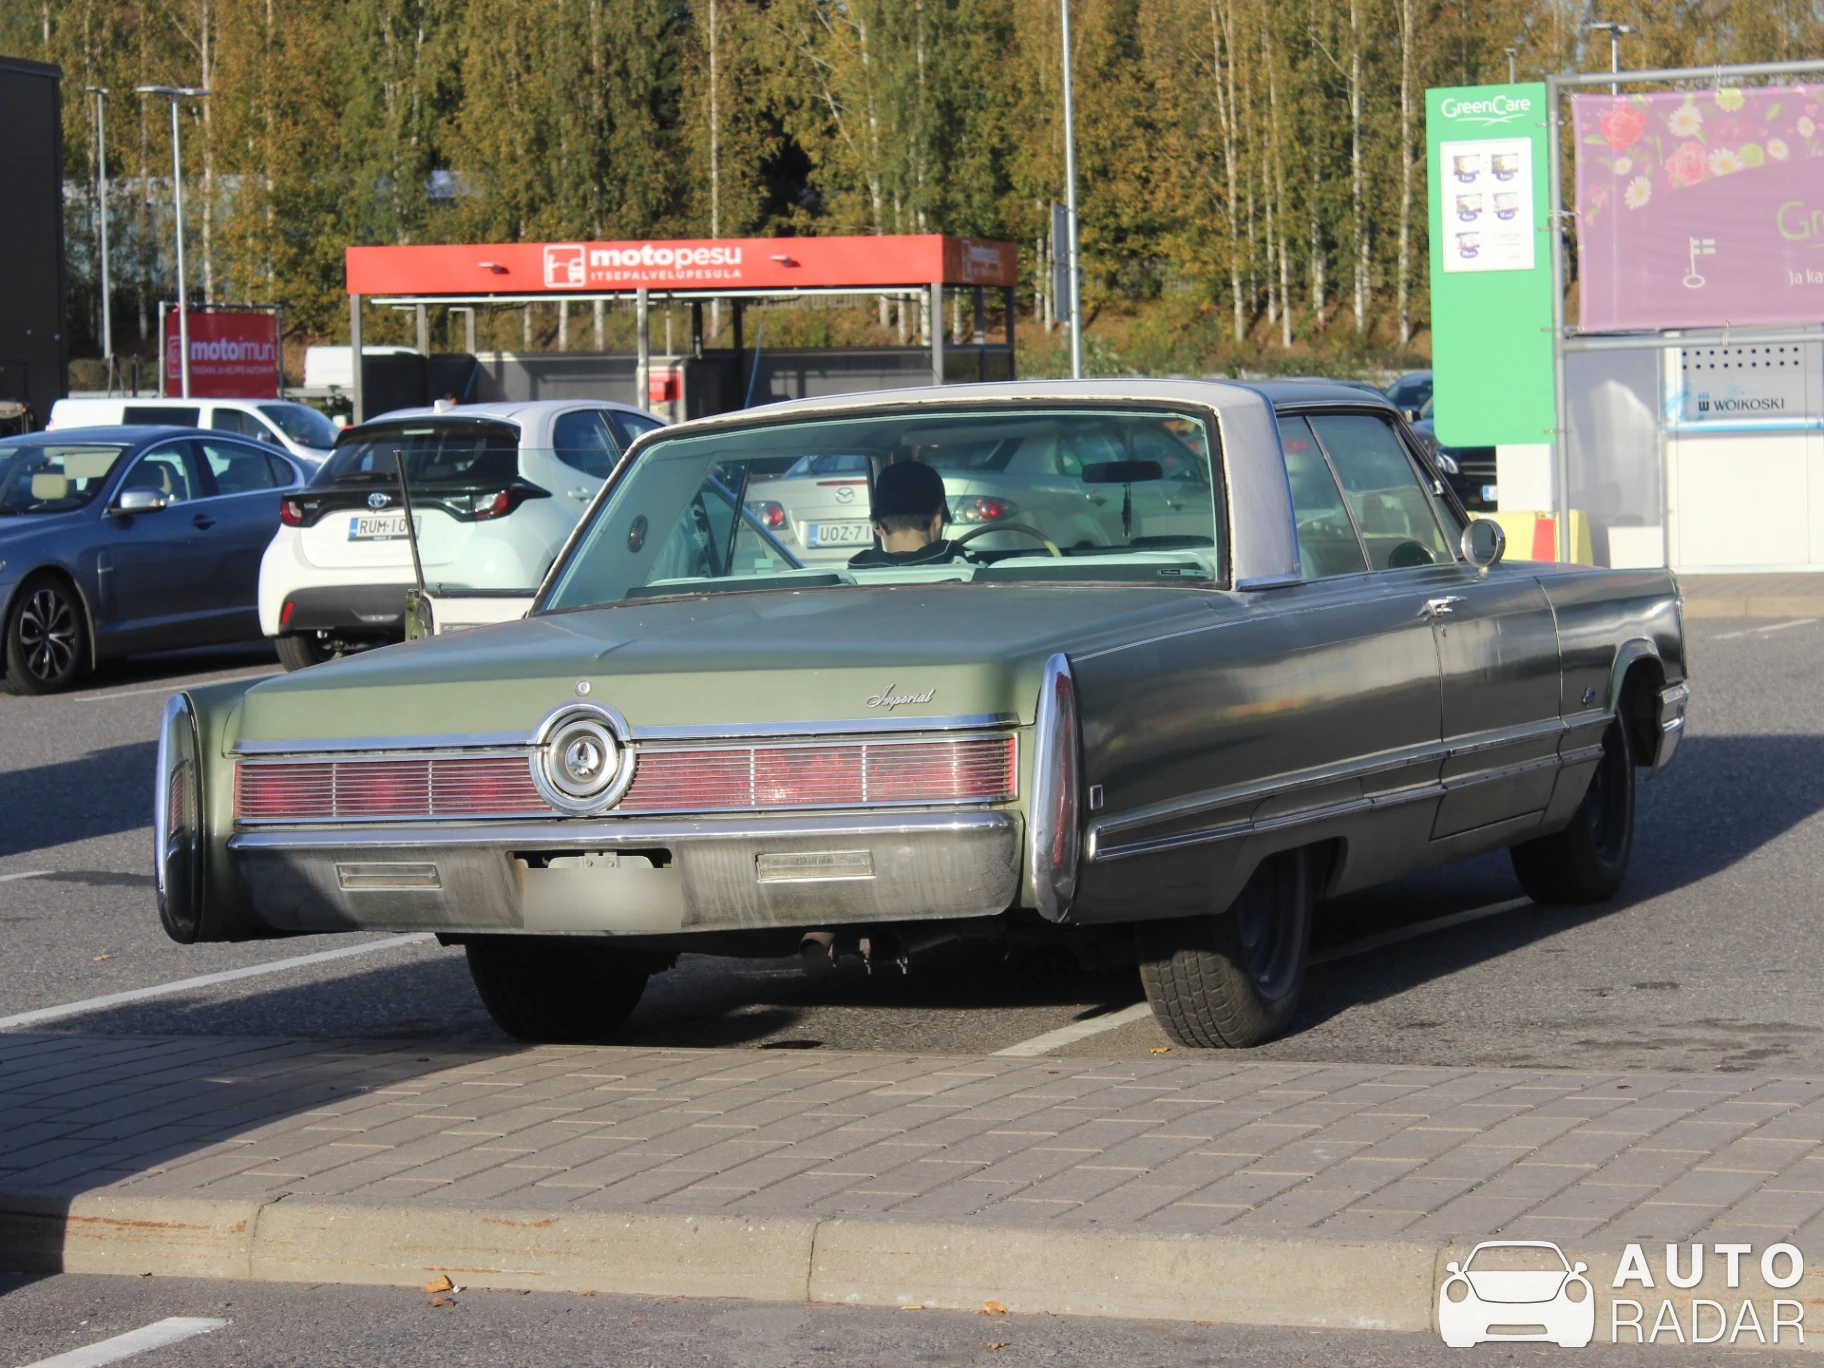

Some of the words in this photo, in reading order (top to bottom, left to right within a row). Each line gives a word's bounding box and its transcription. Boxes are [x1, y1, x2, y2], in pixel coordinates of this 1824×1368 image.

[1441, 95, 1531, 118] GreenCare
[1776, 200, 1824, 241] Gr
[590, 244, 742, 270] motopesu
[591, 269, 742, 281] ITSEPALVELUPESULA
[1806, 268, 1824, 284] ka
[1714, 398, 1785, 411] WOIKOSKI
[820, 525, 872, 541] UOZ-71
[866, 683, 936, 711] Imperial
